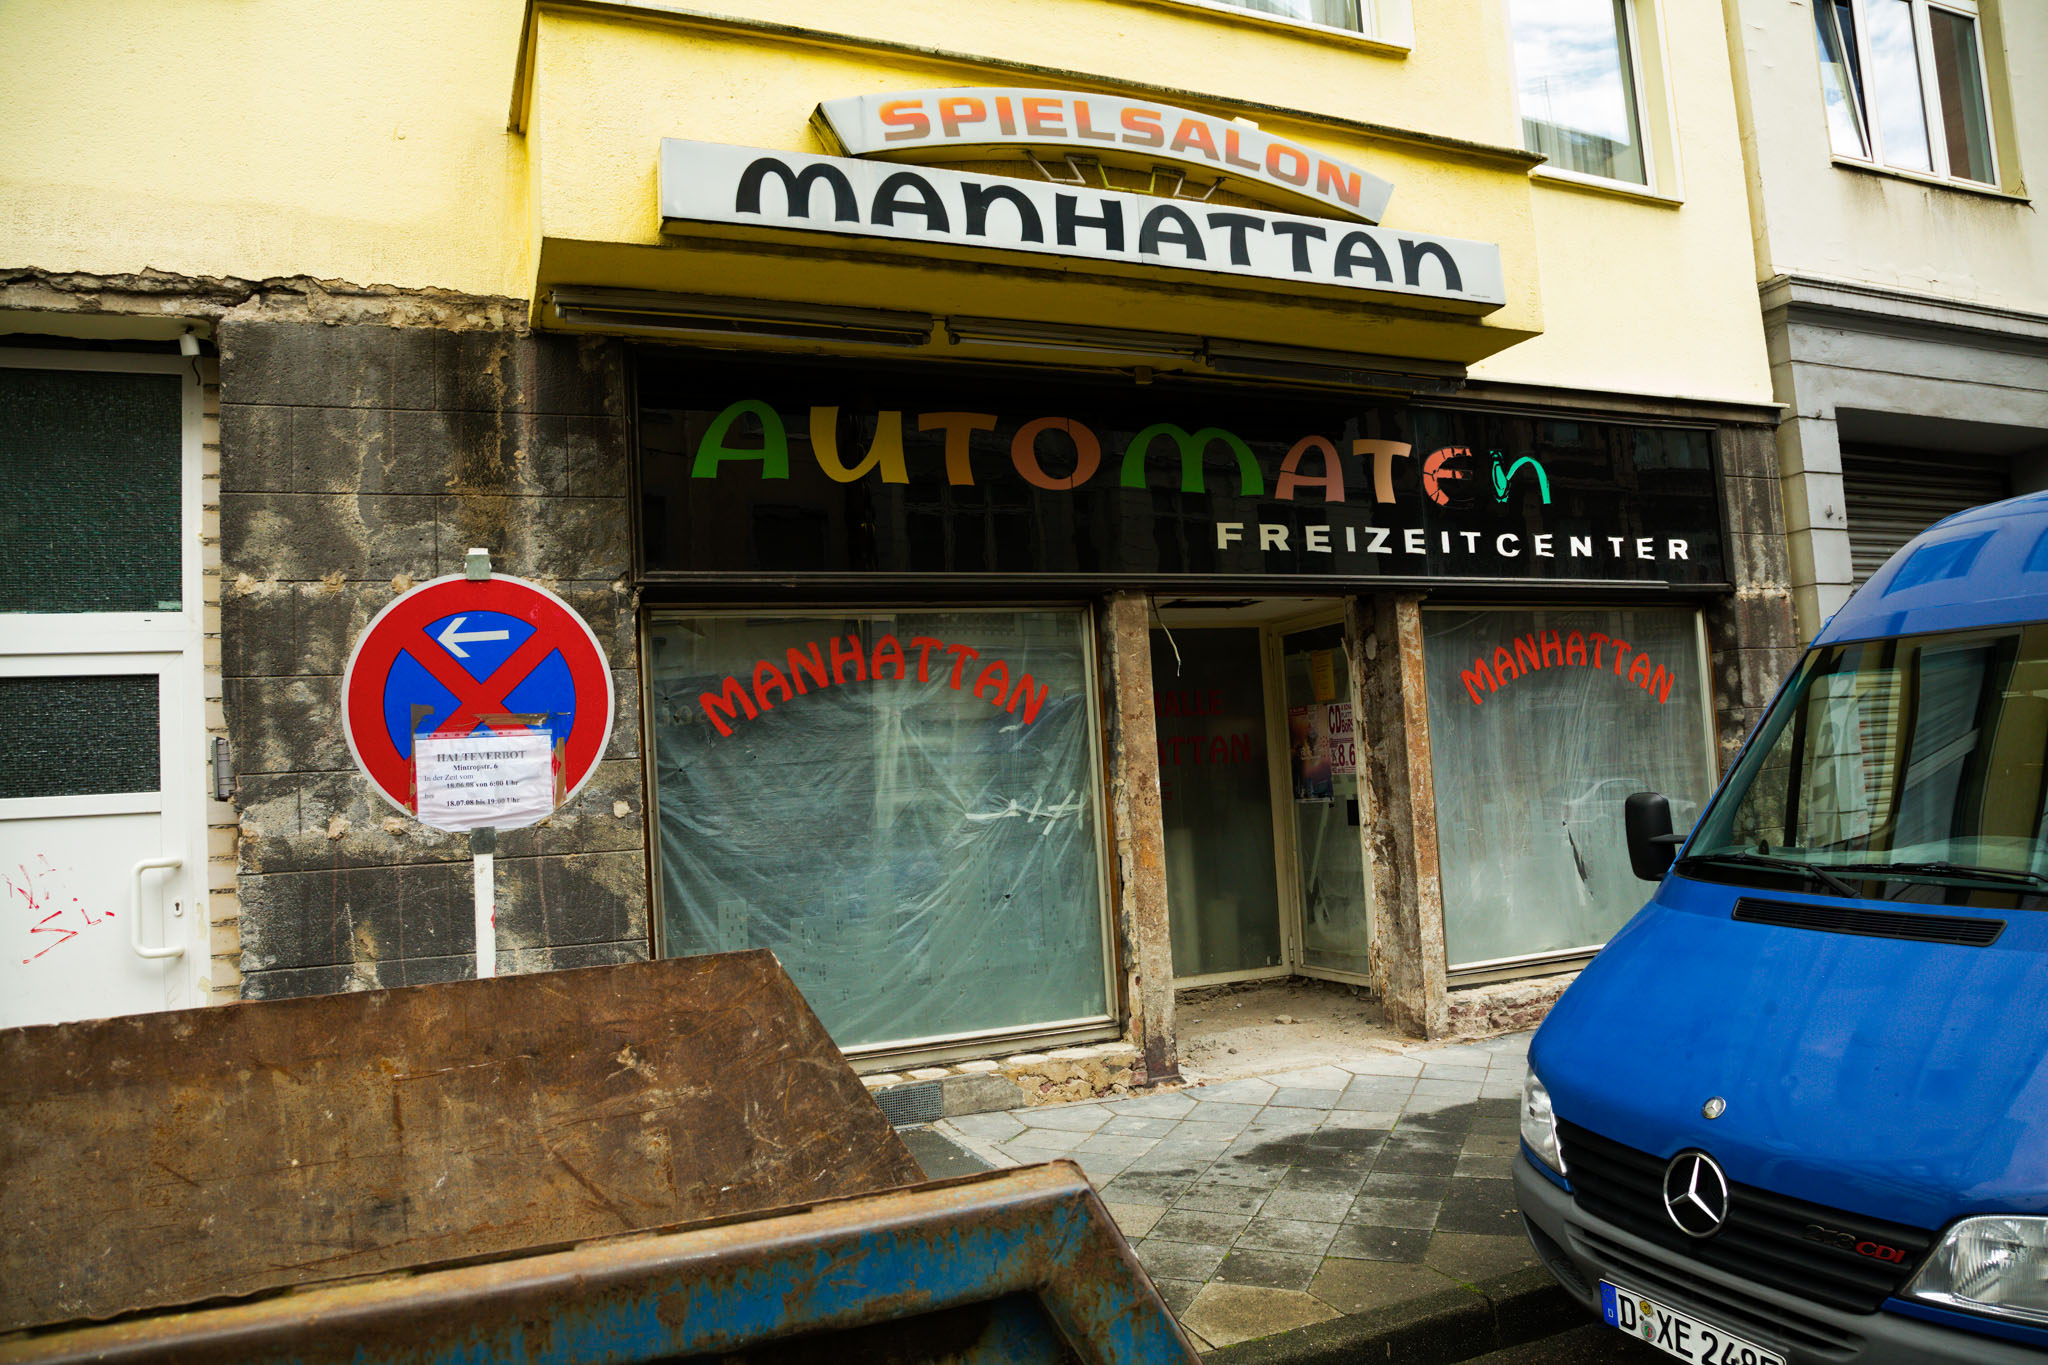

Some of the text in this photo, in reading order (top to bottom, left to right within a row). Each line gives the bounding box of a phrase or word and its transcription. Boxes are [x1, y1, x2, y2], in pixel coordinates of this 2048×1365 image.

[878, 96, 1363, 208] SPIELSALON
[735, 156, 1464, 292] MANHATTAN
[691, 399, 1551, 506] AUTOMATEN
[1216, 521, 1689, 561] FREIZEITCENTER
[699, 633, 1049, 738] MANHATTAN
[1460, 629, 1676, 706] MANHATTAN
[1328, 705, 1341, 735] CD
[437, 750, 528, 762] HALTEVERBOT
[446, 799, 475, 807] 18.07.08
[1855, 1240, 1907, 1264] CDI
[1618, 1293, 1637, 1331] D
[1657, 1309, 1694, 1359] XE
